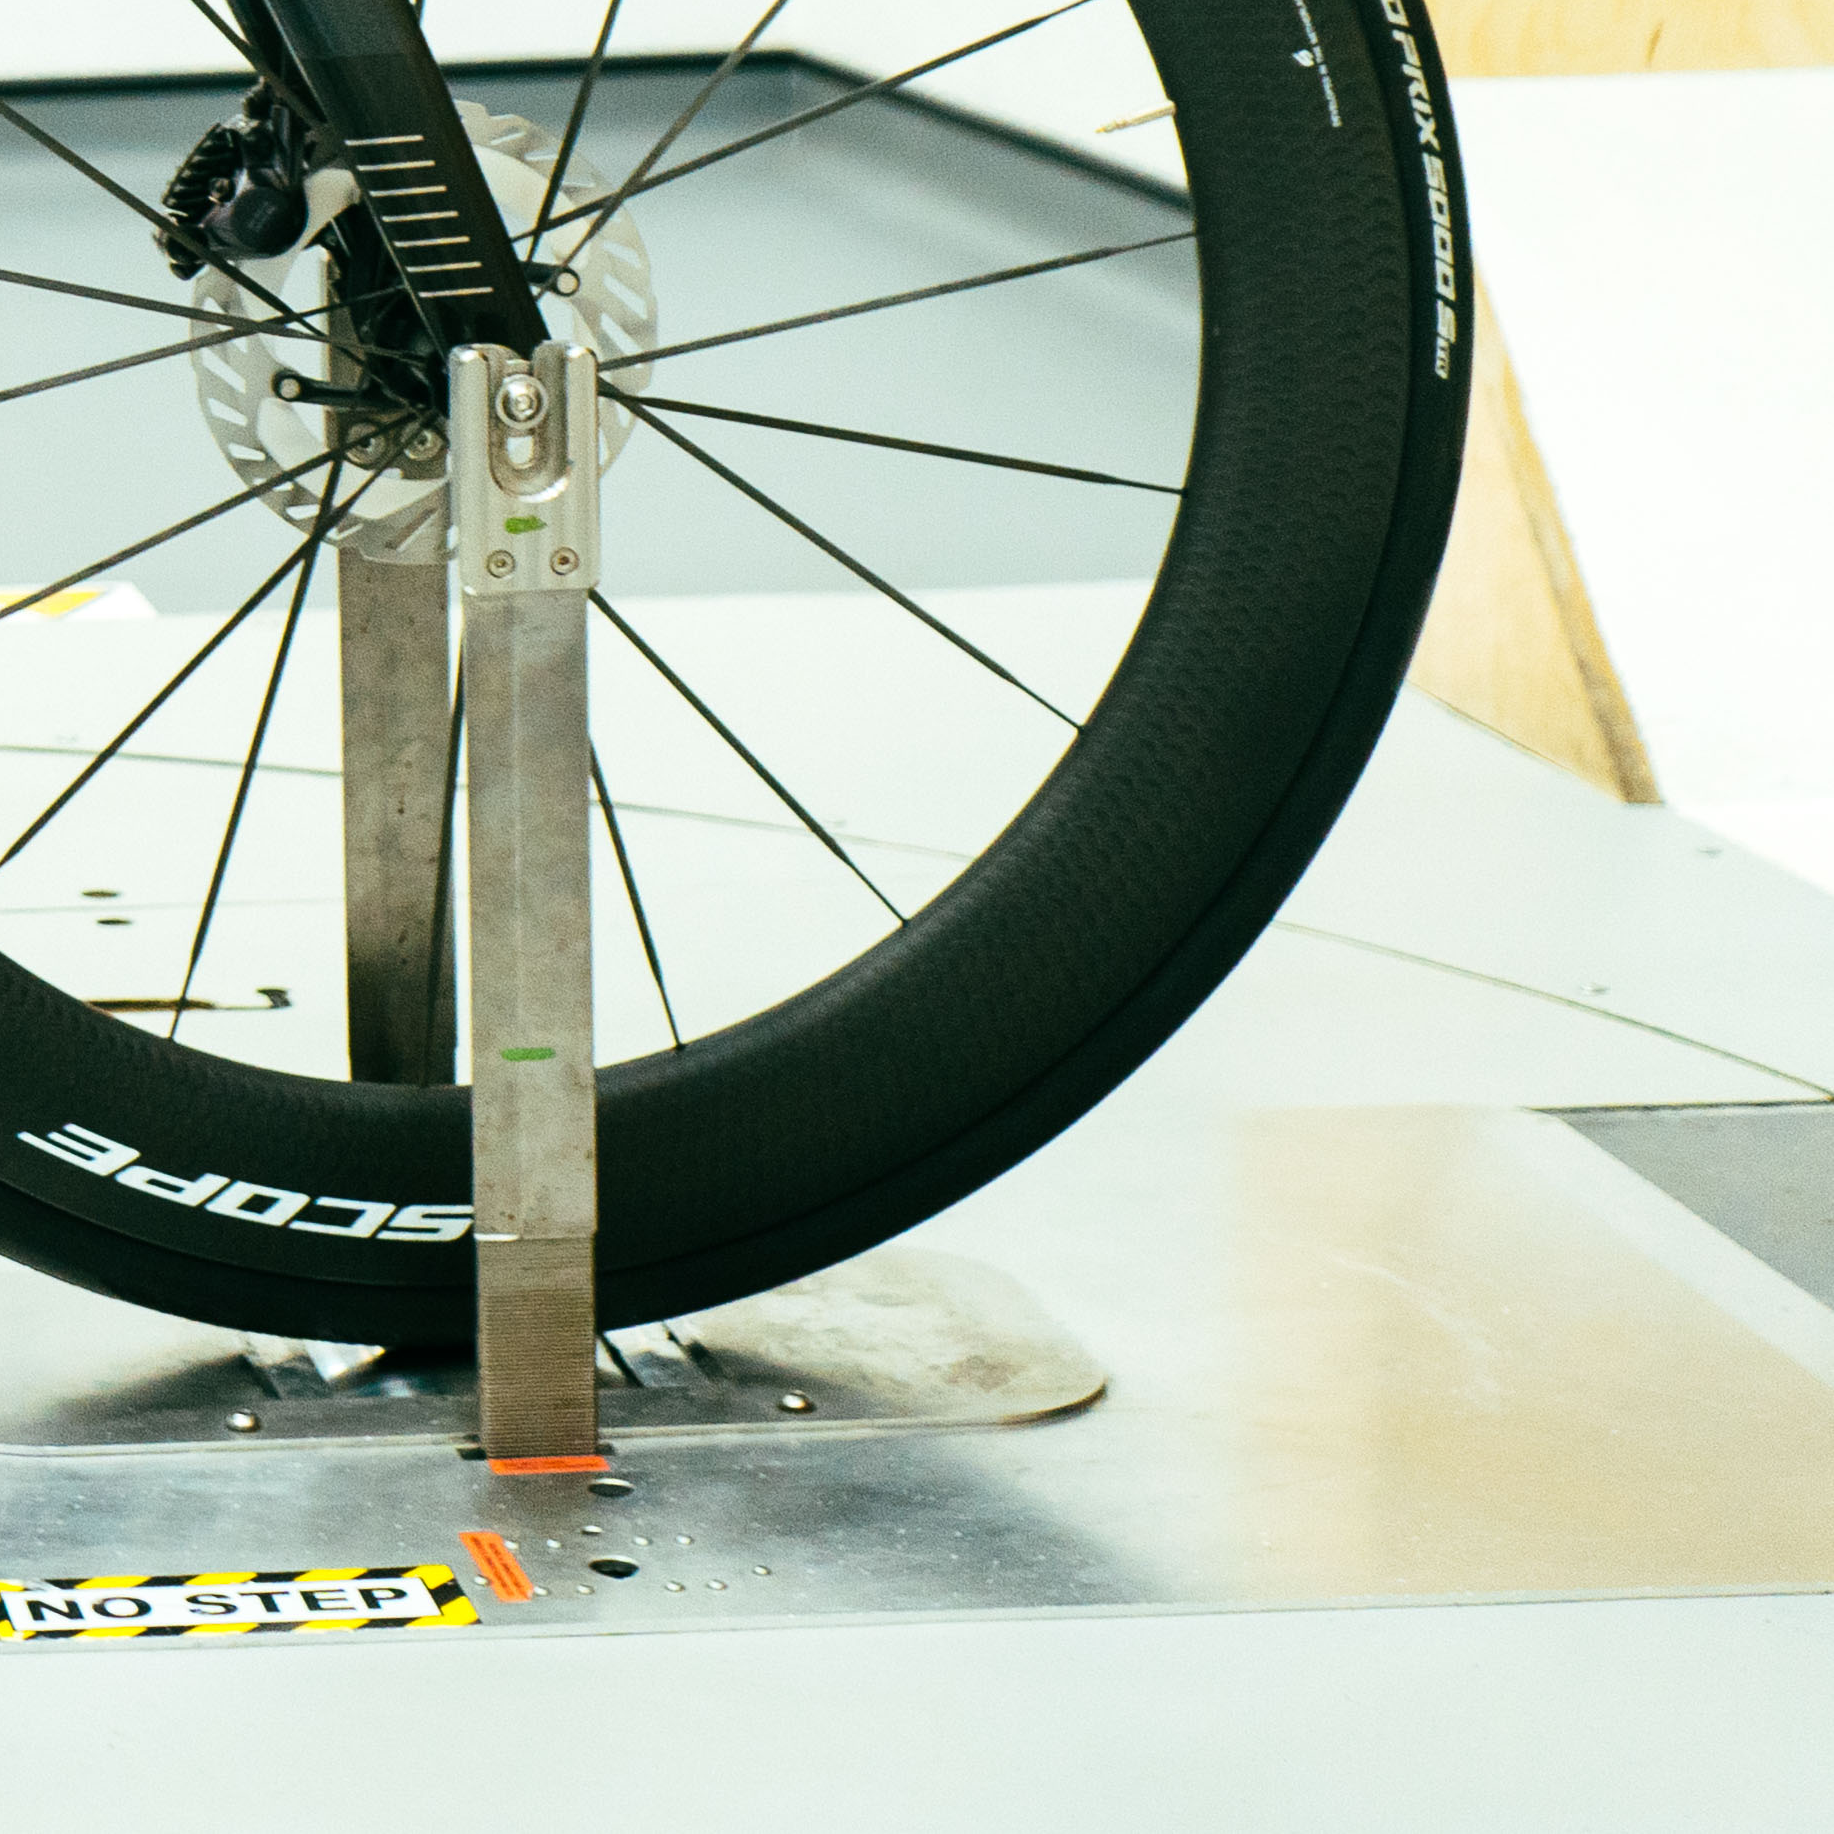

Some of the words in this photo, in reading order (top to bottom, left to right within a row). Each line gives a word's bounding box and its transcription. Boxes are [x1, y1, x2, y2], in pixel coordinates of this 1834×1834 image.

[1392, 27, 1441, 152] PRIX
[1422, 151, 1456, 303] 5000
[17, 1123, 475, 1242] SCOPE
[26, 1596, 152, 1622] NO
[188, 1586, 410, 1615] STEP
